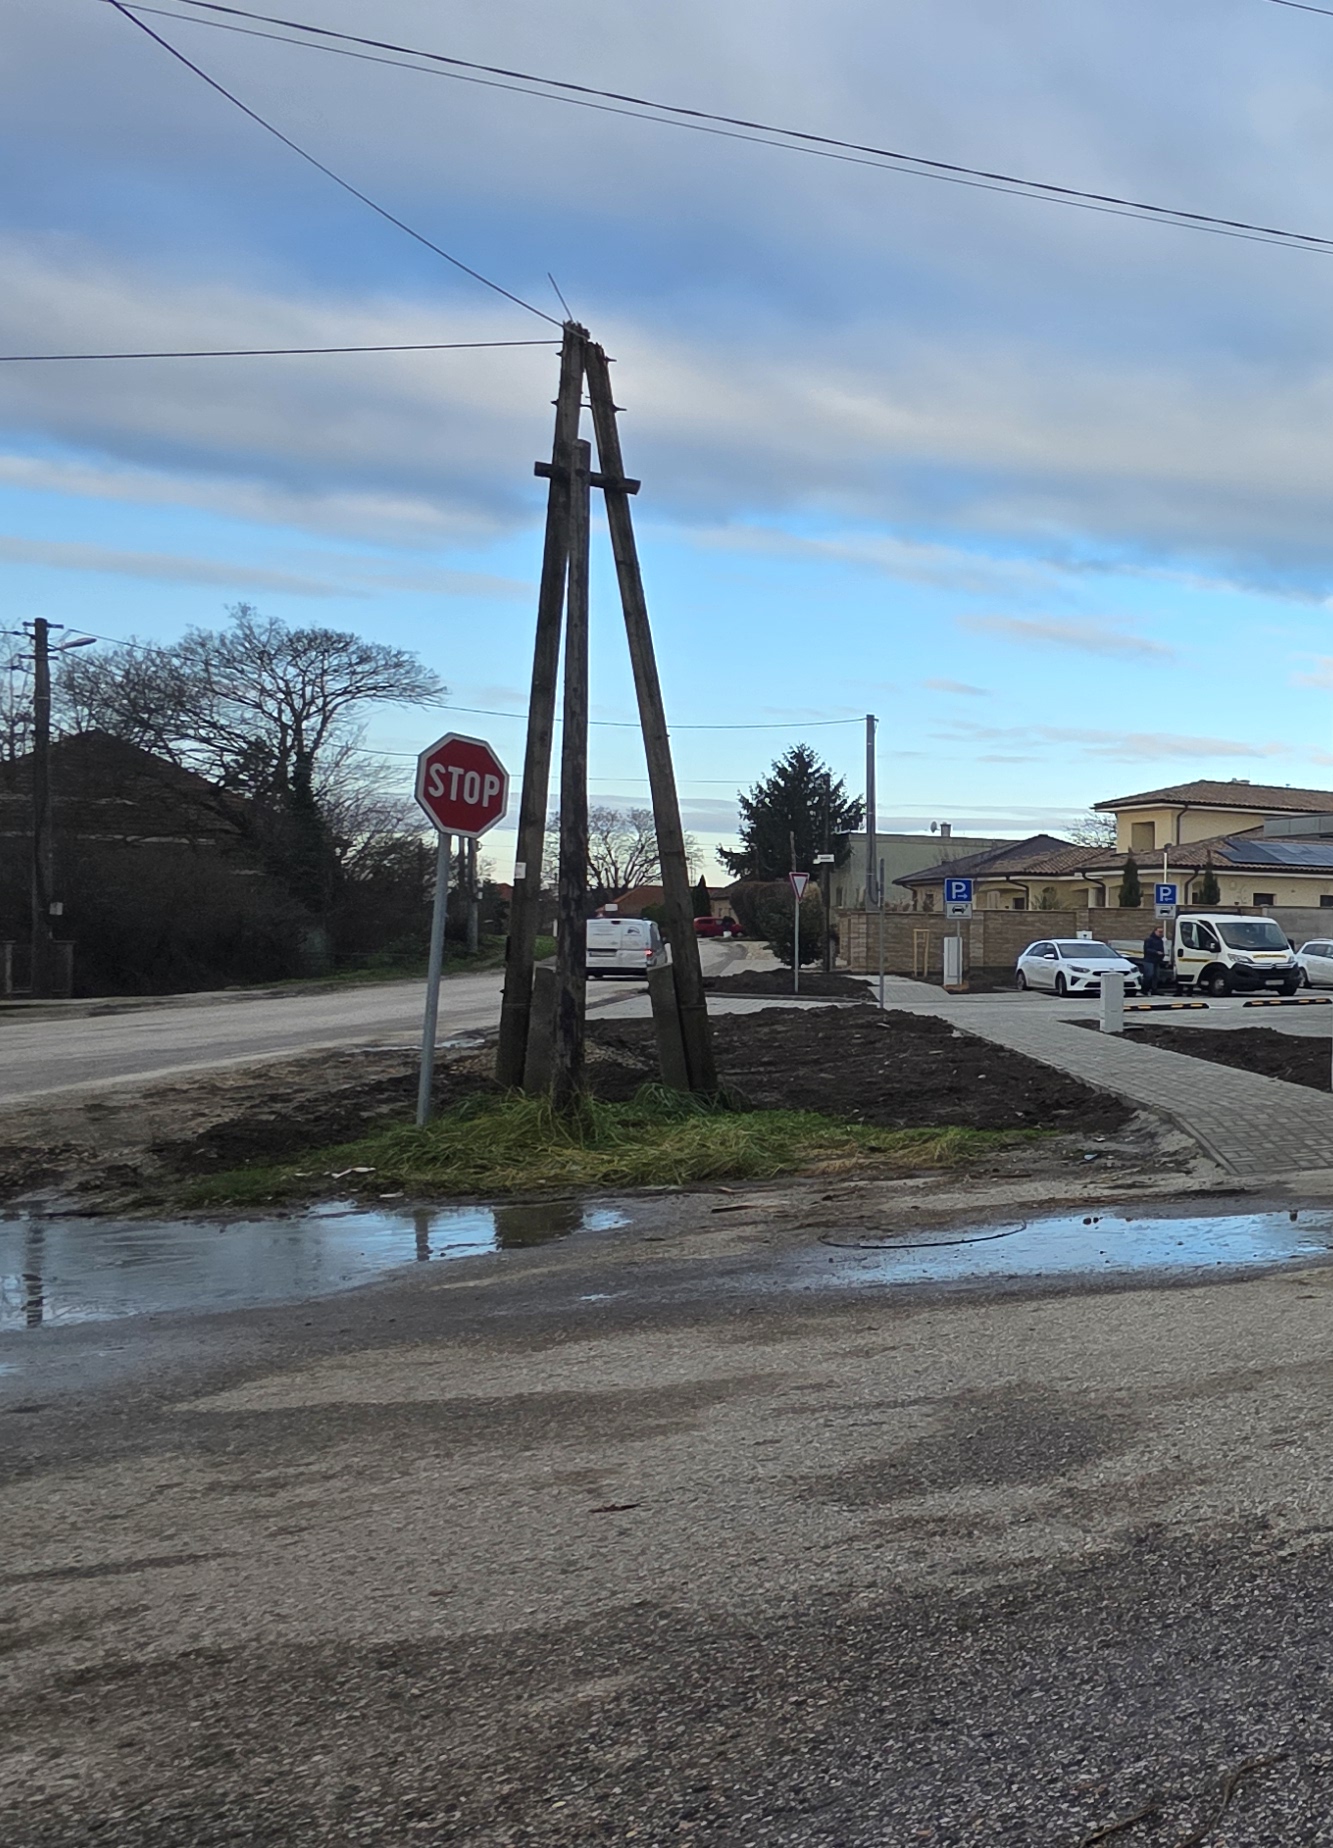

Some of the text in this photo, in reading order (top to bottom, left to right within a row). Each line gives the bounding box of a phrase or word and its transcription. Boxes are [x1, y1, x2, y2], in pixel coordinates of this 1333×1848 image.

[428, 763, 500, 808] STOP
[952, 882, 966, 899] P
[1160, 886, 1172, 901] P
